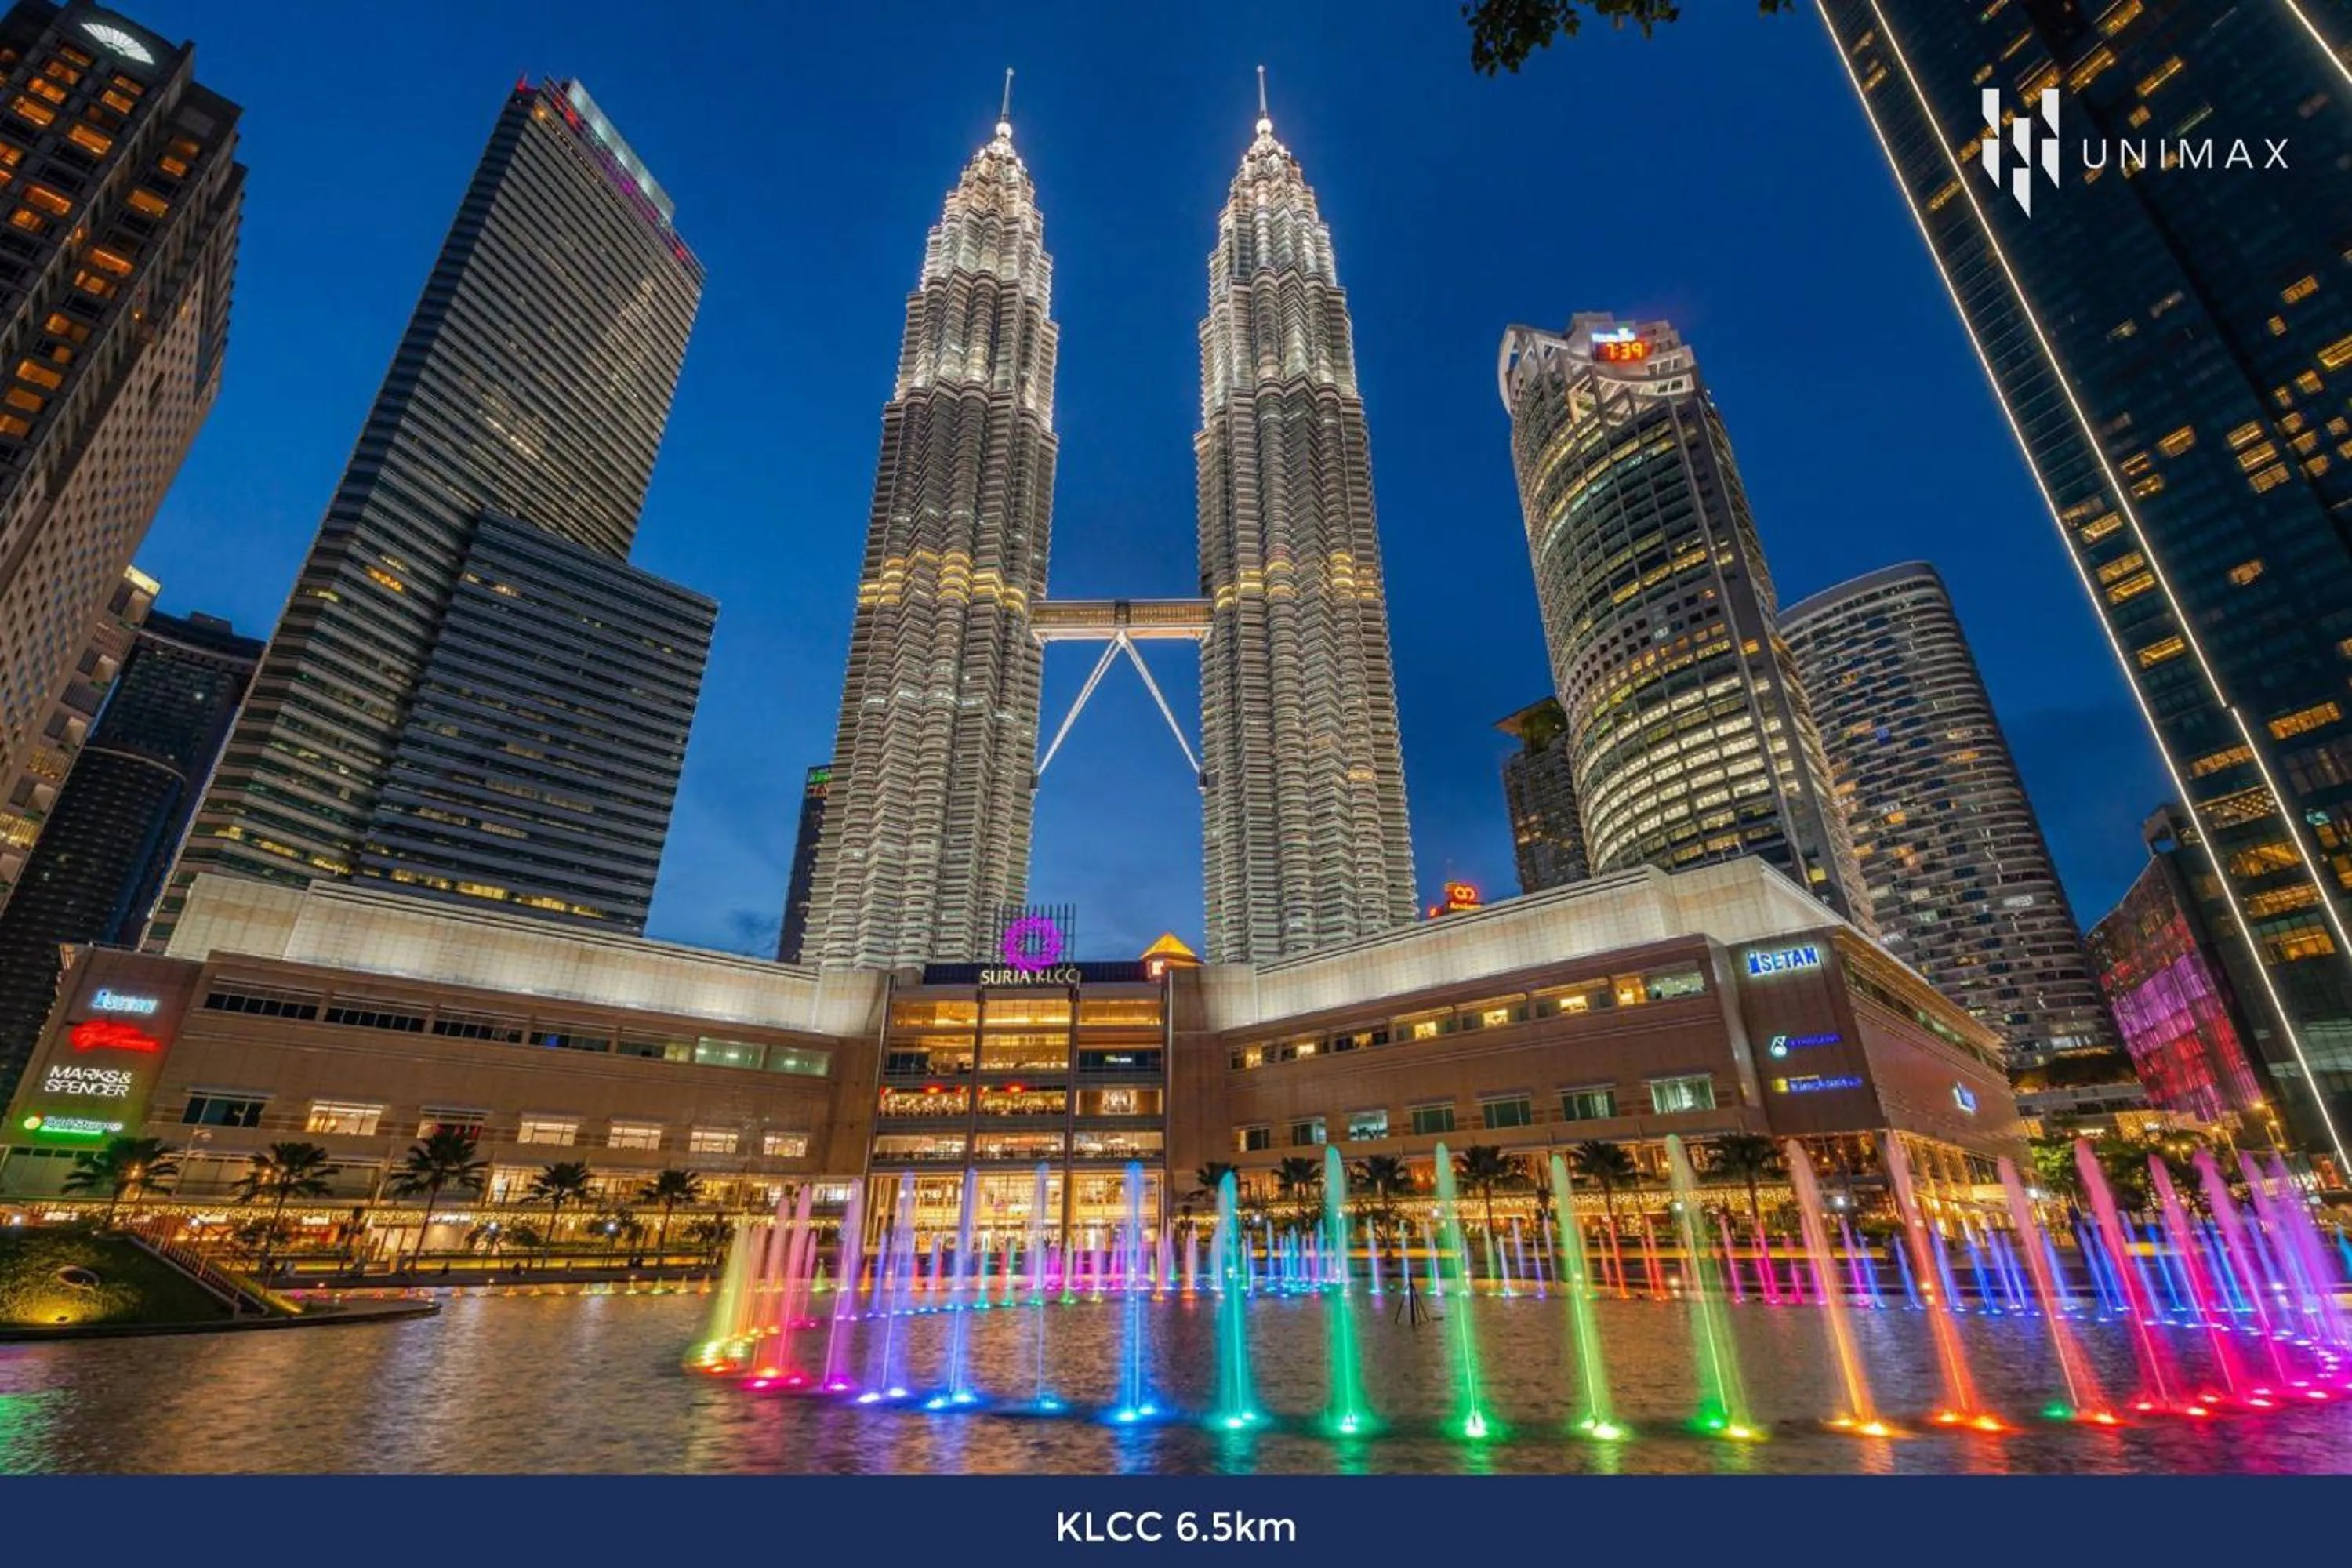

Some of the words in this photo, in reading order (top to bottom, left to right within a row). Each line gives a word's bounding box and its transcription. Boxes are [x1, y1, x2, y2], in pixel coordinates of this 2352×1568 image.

[1606, 342, 1643, 360] 7:39
[1747, 946, 1819, 975] ISETAN
[981, 969, 1032, 985] SURIA
[1036, 968, 1077, 984] KLCC
[49, 1065, 120, 1083] MARKS
[119, 1071, 132, 1084] &
[44, 1078, 130, 1098] SPENCER
